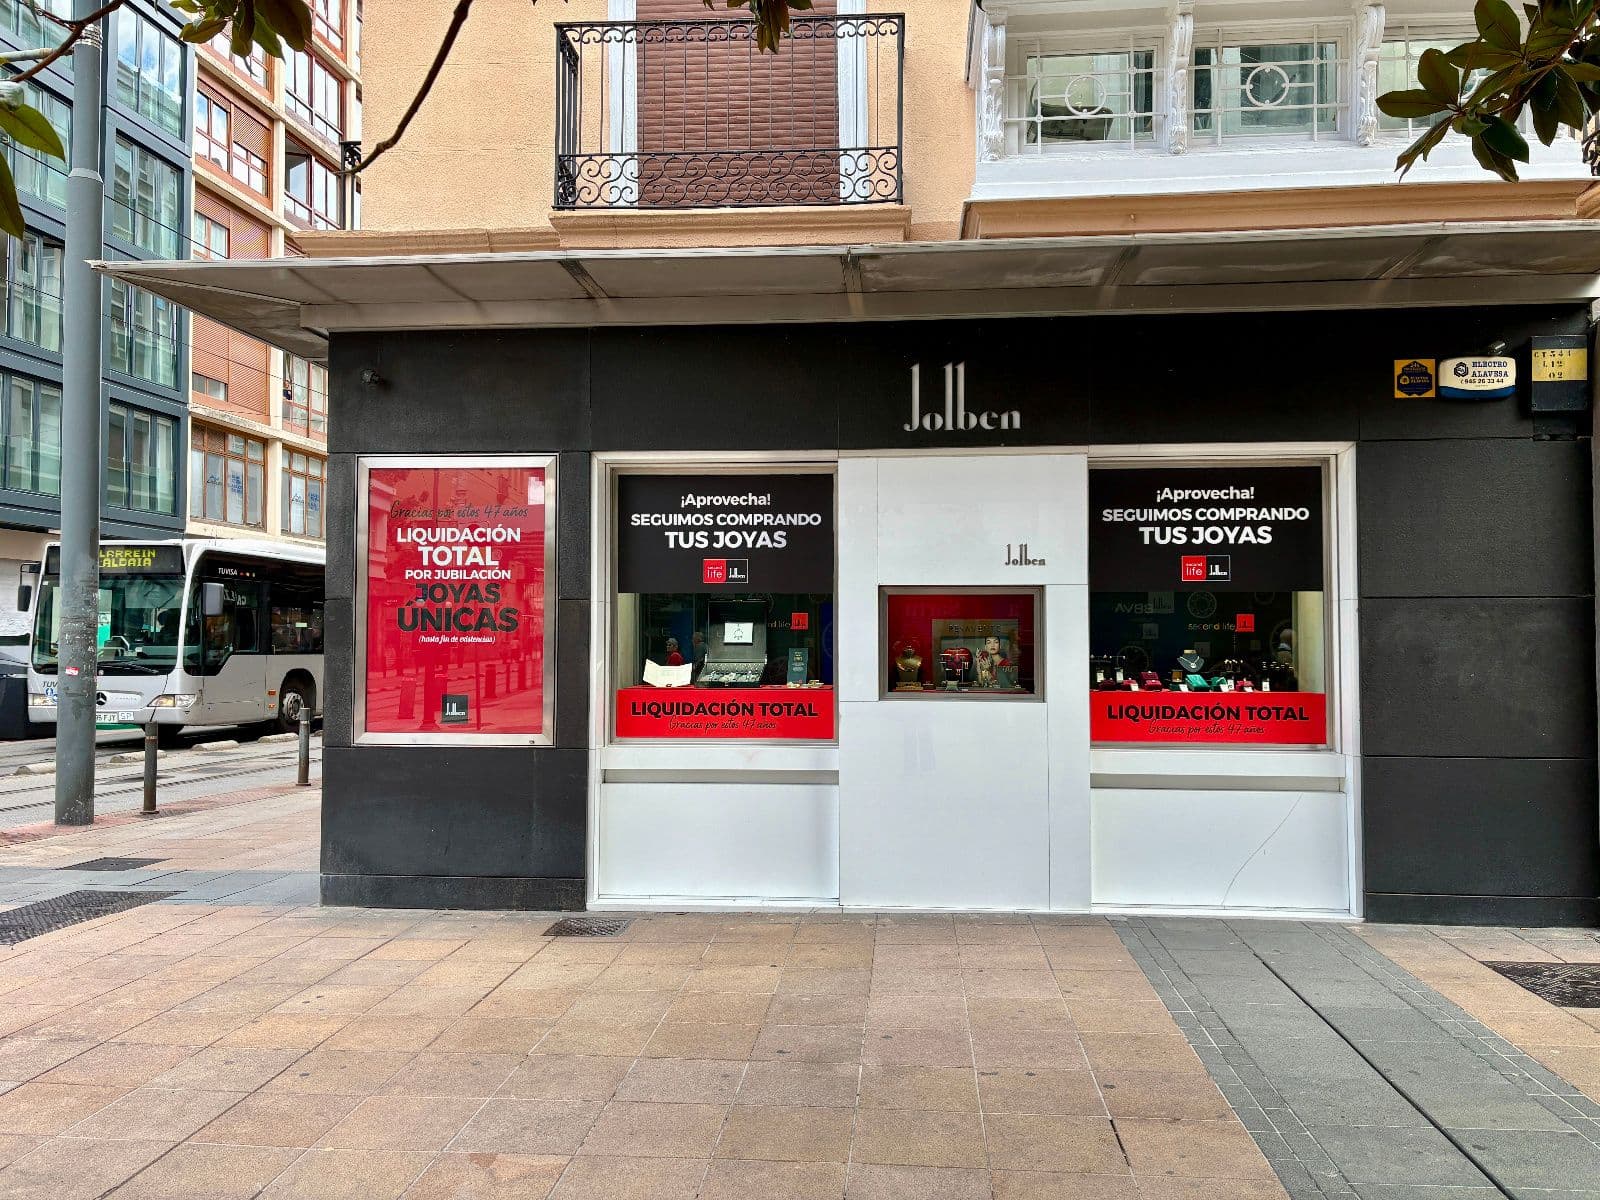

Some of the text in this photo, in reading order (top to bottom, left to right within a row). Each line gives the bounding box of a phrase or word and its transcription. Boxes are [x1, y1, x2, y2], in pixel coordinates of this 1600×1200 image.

[903, 361, 1021, 432] Jolben
[680, 493, 771, 508] ¡Aprovecha!
[1156, 486, 1255, 503] ¡Aprovecha!
[390, 500, 433, 519] Gracias
[457, 504, 480, 518] estos
[484, 504, 502, 518] 47
[502, 504, 529, 518] años
[1102, 507, 1310, 522] SEGUIMOS COMPRANDO
[630, 513, 822, 526] SEGUIMOS COMPRANDO
[396, 525, 521, 545] LIQUIDACIÓN
[664, 530, 788, 549] TUS JOYAS
[1138, 526, 1273, 545] TUS JOYAS
[99, 549, 156, 558] LARREIN
[417, 545, 500, 567] TOTAL
[1004, 543, 1046, 566] Jolben
[405, 567, 512, 580] POR JUBILACIÓN
[707, 570, 723, 578] life
[1186, 566, 1203, 576] life
[414, 583, 501, 604] JOYAS
[397, 600, 519, 632] ÚNICAS
[418, 635, 439, 644] (hasta
[439, 635, 450, 645] fin
[450, 635, 458, 643] de
[631, 698, 818, 718] LIQUIDACIÓN TOTAL
[1107, 702, 1310, 722] LIQUIDACIÓN TOTAL
[668, 715, 703, 729] Gracias
[705, 720, 719, 735] por
[721, 719, 739, 729] estos
[742, 719, 756, 729] 47
[1148, 719, 1186, 734] Gracias
[1187, 726, 1201, 738] por
[1204, 721, 1225, 734] estos
[1227, 723, 1242, 734] 47
